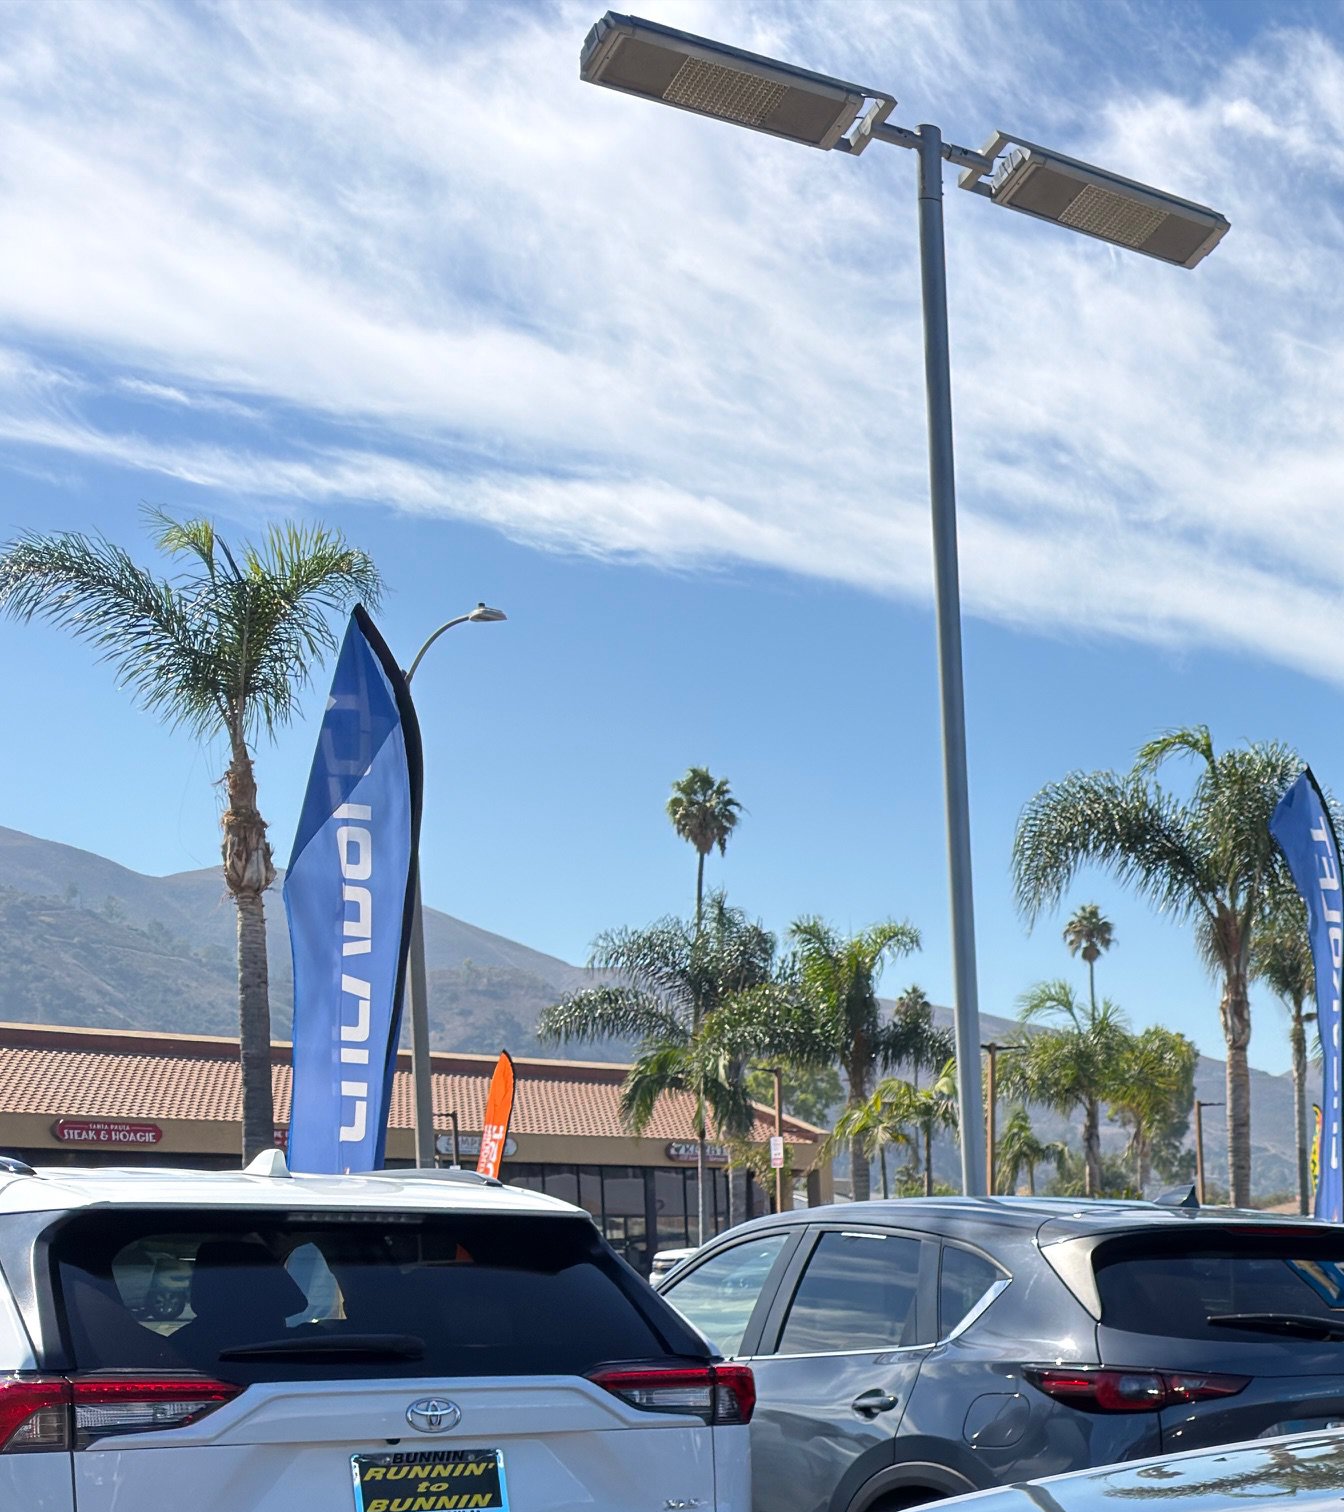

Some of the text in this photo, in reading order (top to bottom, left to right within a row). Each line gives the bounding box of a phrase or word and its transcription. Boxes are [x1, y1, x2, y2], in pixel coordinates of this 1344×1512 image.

[64, 1129, 156, 1143] STEAK & HOAGIE
[392, 1450, 465, 1465] BUNNIN
[416, 1481, 450, 1493] to
